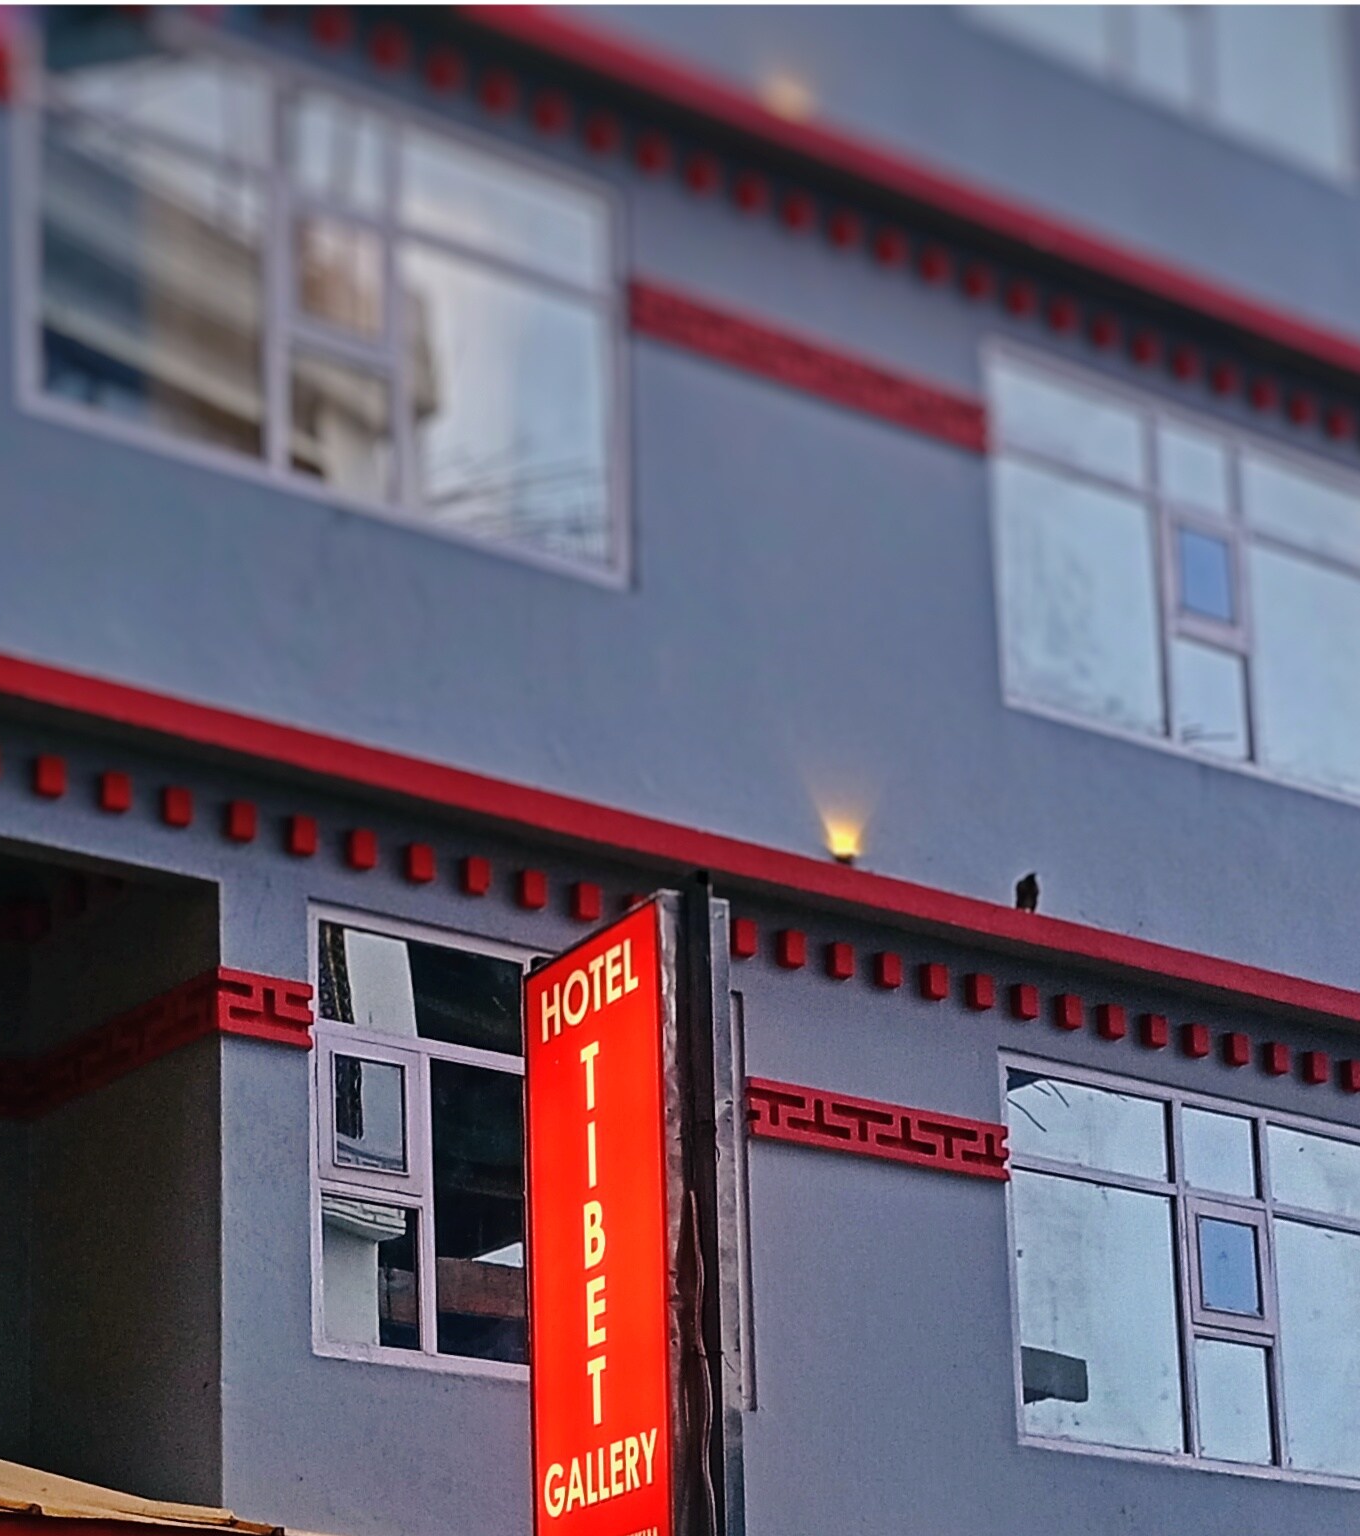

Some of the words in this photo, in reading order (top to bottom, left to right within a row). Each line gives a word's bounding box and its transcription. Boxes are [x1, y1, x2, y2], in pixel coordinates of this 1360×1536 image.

[540, 938, 639, 1044] HOTEL
[580, 1041, 607, 1425] TIBET
[544, 1428, 657, 1518] GALLERY
